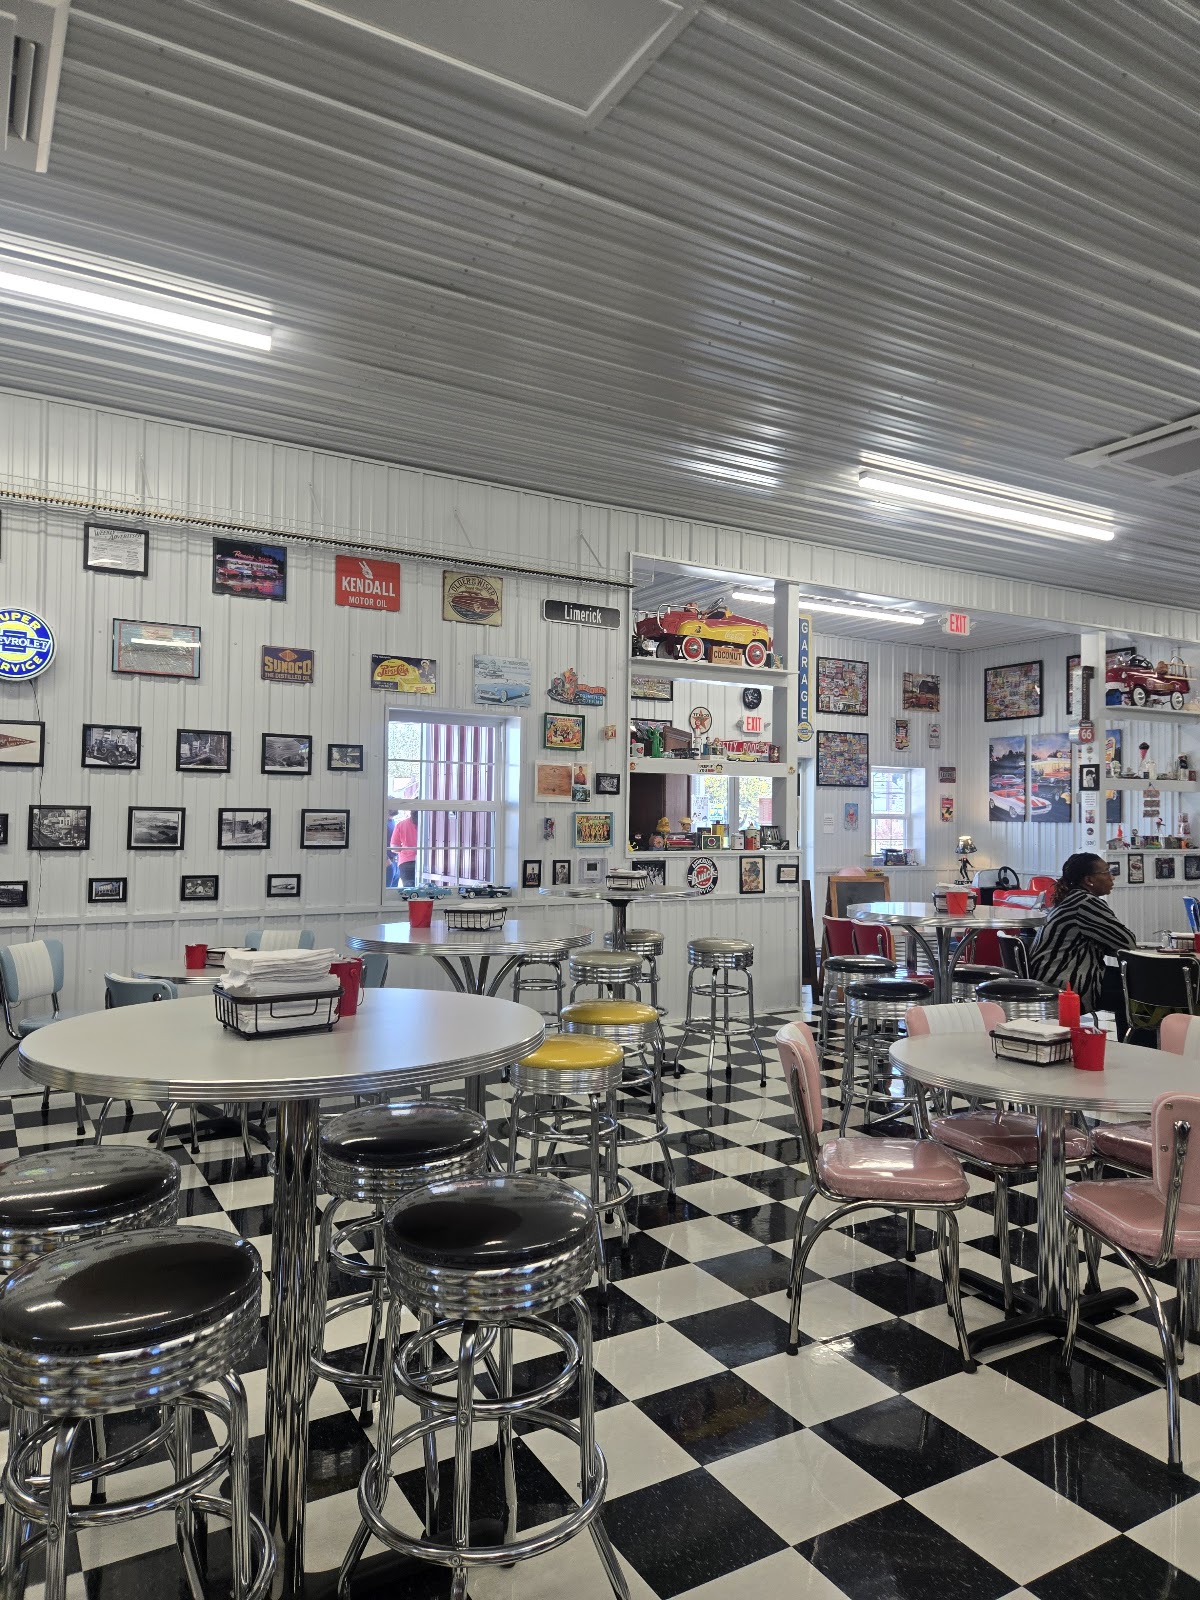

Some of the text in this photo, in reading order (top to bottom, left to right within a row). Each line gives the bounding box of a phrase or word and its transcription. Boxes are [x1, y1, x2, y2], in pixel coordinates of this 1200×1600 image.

[342, 576, 396, 597] KENDALL
[348, 595, 388, 608] MOTOR OIL
[0, 612, 41, 631] UPER
[564, 604, 602, 624] Limerick
[949, 612, 968, 635] EXIT
[264, 655, 312, 675] SUNOCO
[713, 650, 742, 661] COCONUT
[746, 716, 763, 732] EXIT
[1081, 728, 1092, 740] 66
